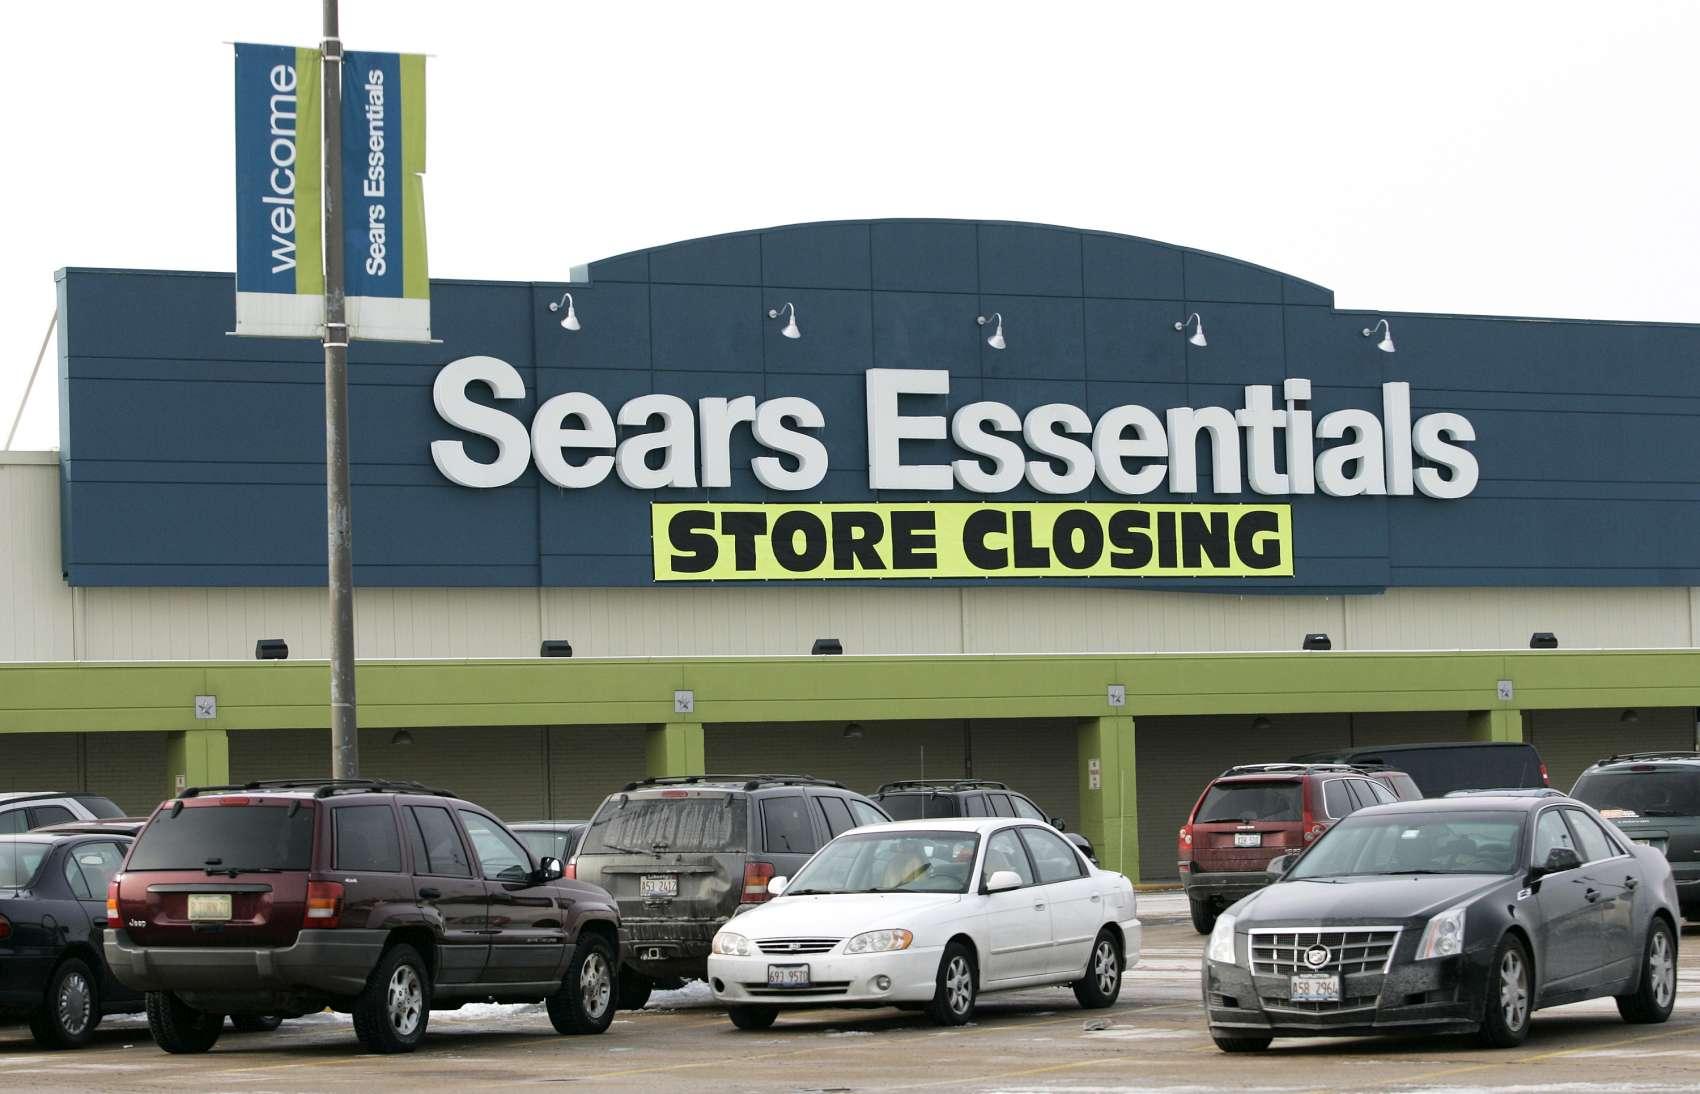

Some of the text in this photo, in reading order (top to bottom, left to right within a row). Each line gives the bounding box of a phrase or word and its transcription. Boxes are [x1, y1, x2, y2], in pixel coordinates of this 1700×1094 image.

[262, 63, 296, 274] welcome
[363, 69, 386, 277] Sears Essentials
[430, 355, 1479, 499] Sears Essentials
[668, 509, 1281, 573] STORE CLOSING
[129, 919, 147, 928] Jeep
